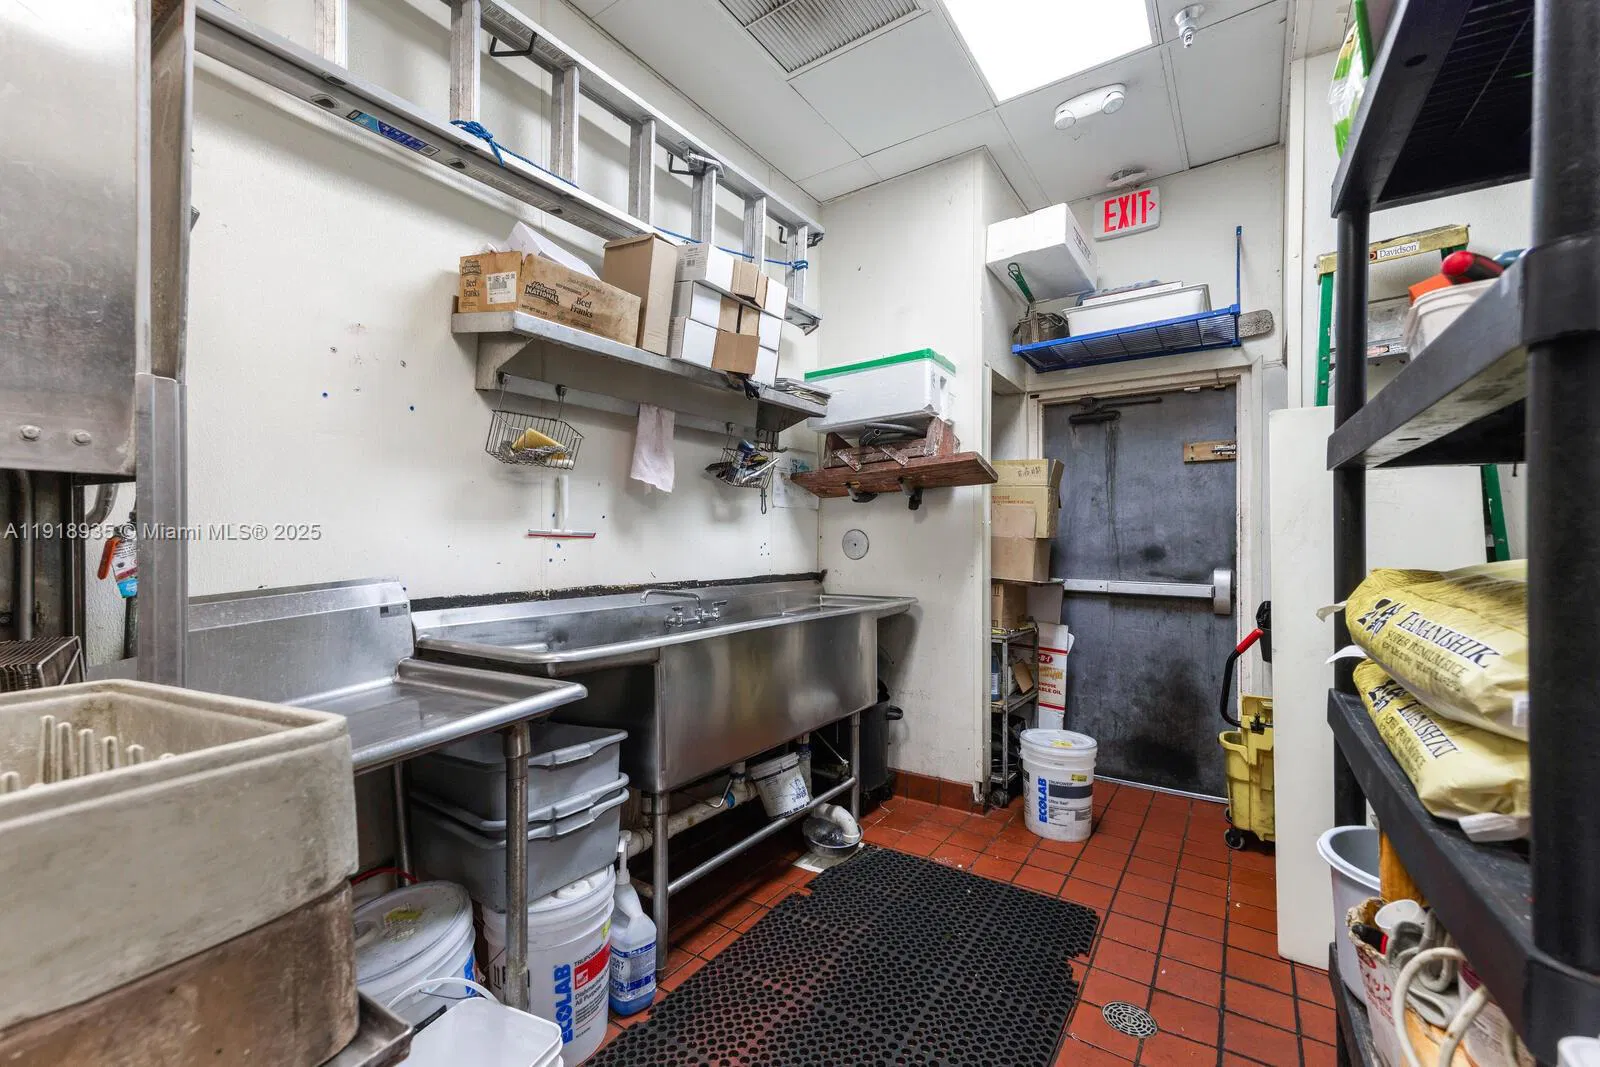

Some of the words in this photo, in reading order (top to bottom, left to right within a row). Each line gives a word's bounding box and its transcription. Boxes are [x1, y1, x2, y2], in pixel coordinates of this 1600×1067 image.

[1104, 190, 1151, 233] EXIT
[1379, 242, 1417, 258] Davidson
[525, 285, 560, 305] NATIONAL
[530, 281, 557, 296] Hebrew
[570, 304, 593, 318] Franks
[576, 296, 592, 309] Beef
[1038, 776, 1048, 823] ECOLAB
[554, 964, 574, 1044] ECOLAB
